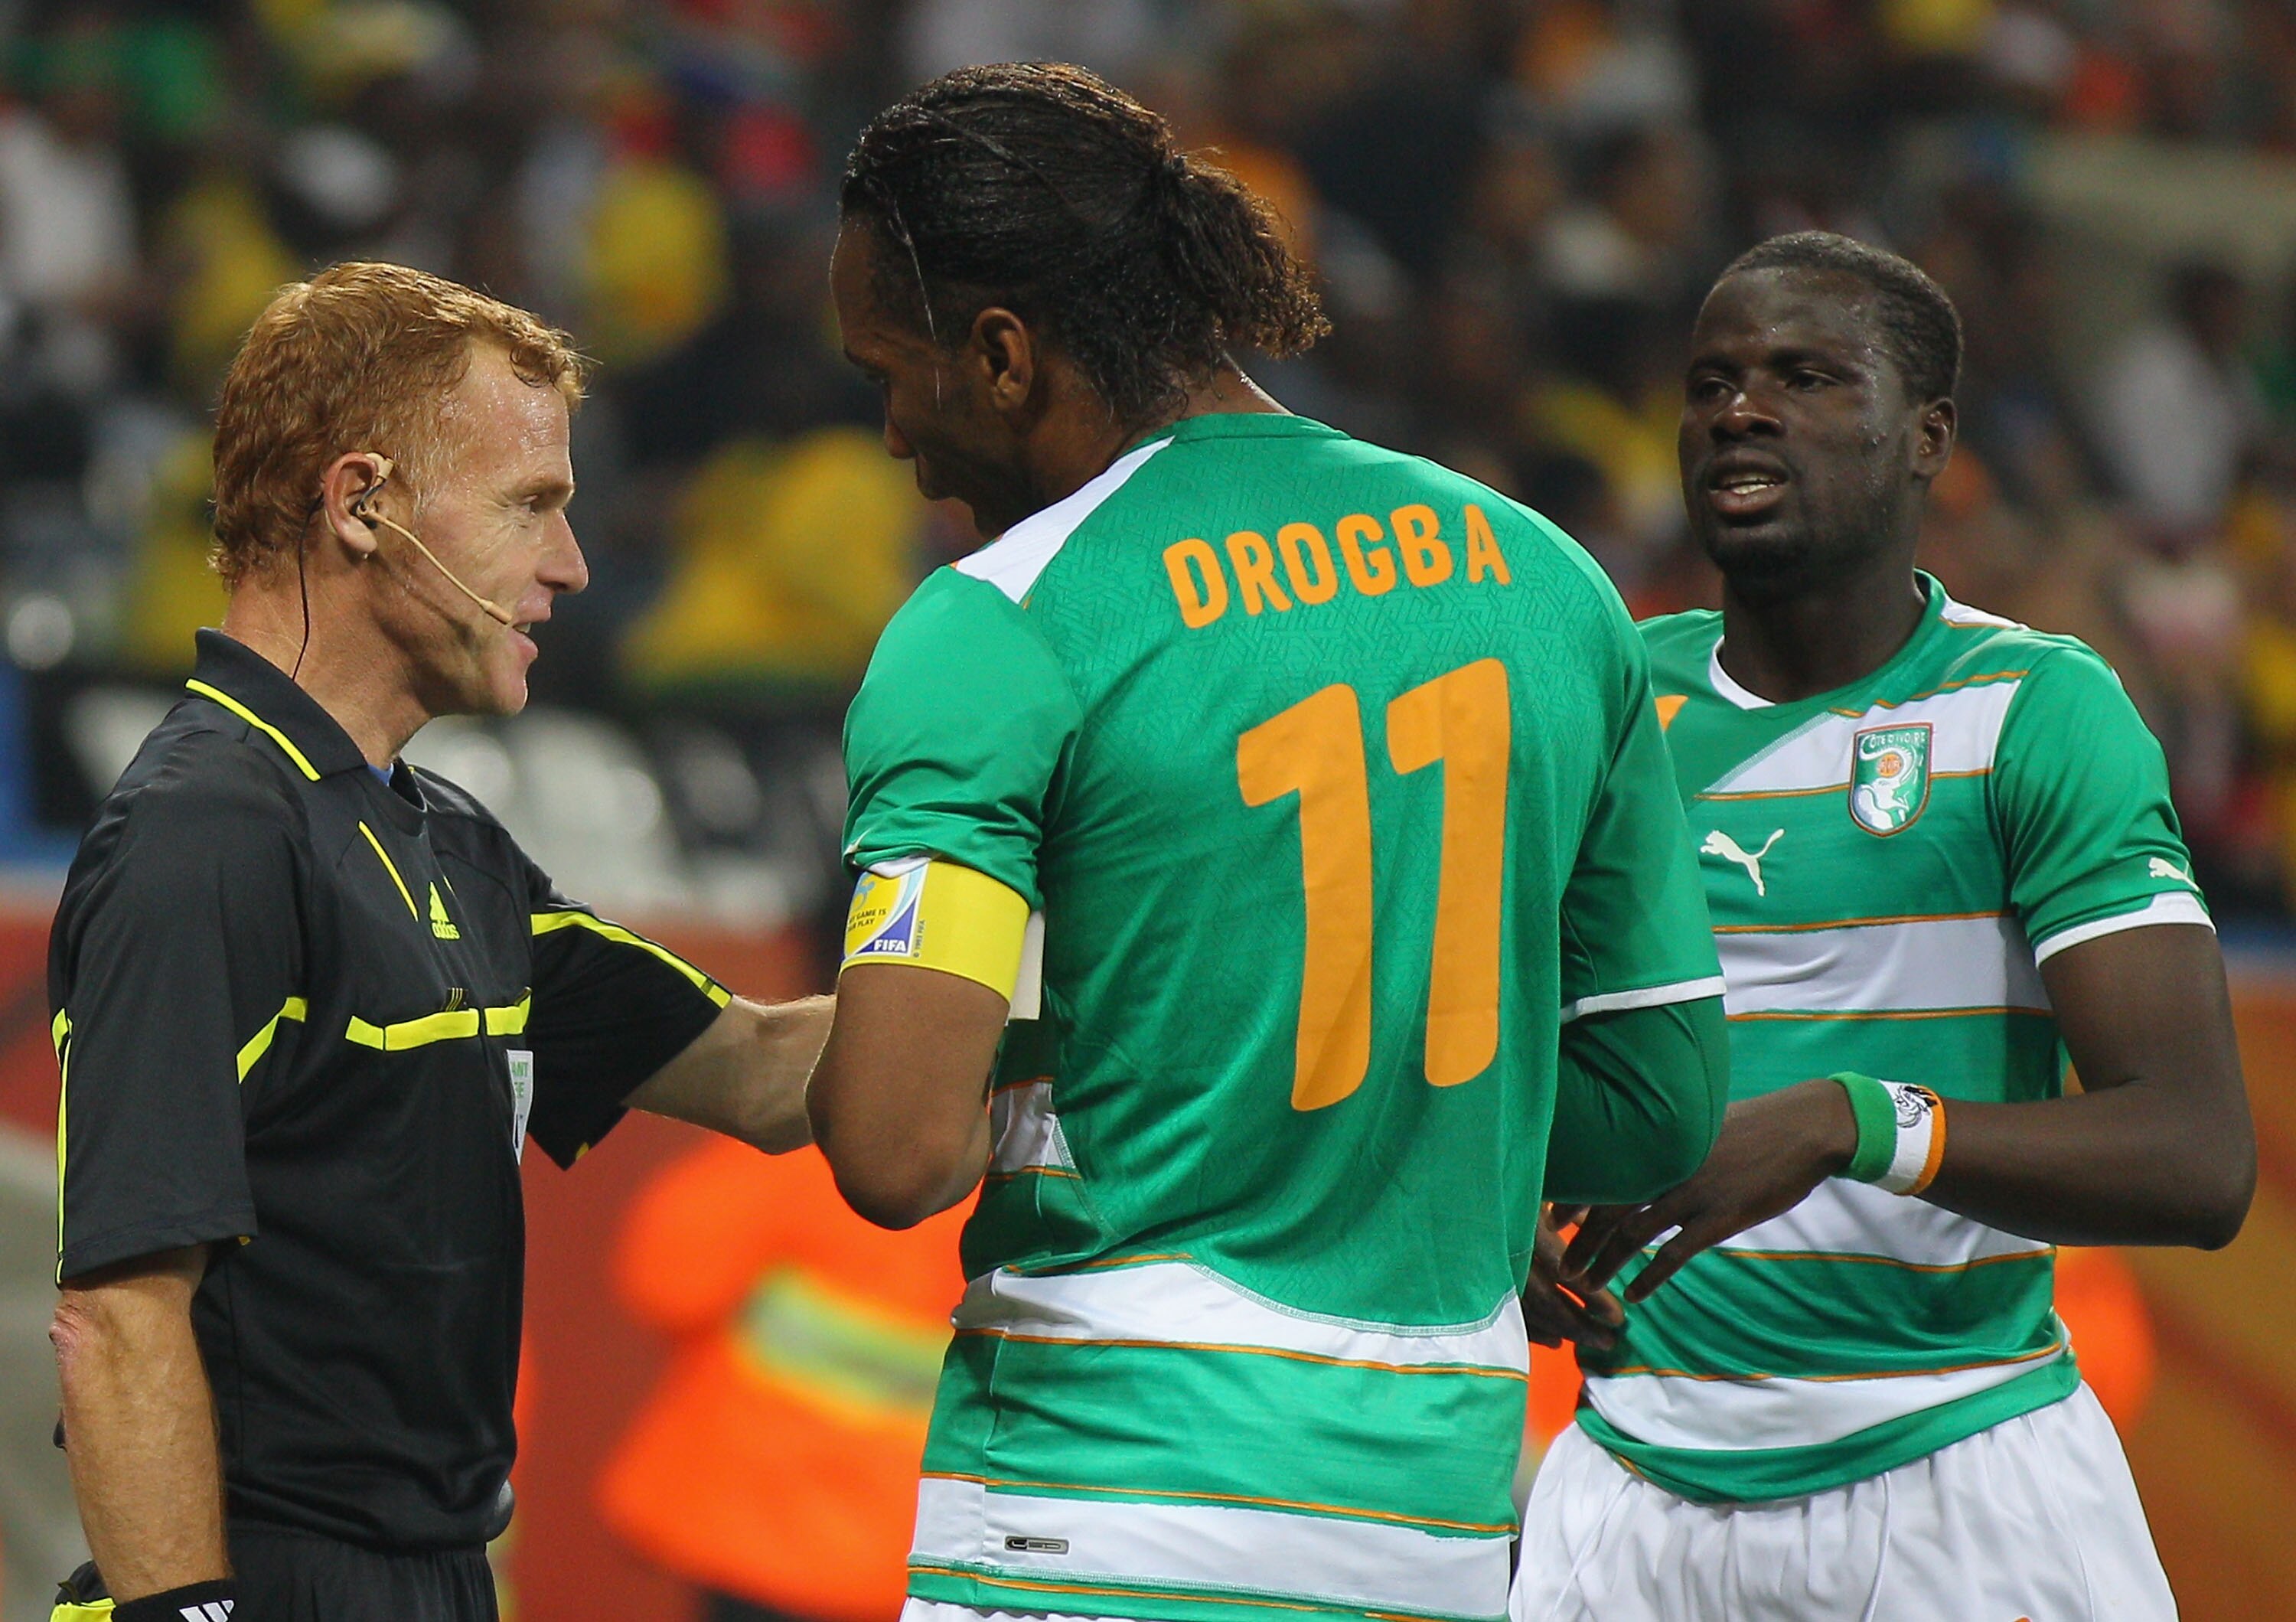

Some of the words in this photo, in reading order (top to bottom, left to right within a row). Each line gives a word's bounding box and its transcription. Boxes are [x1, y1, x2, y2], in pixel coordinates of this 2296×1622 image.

[1163, 504, 1512, 628] DROGBA
[1236, 658, 1511, 1111] 11
[857, 918, 876, 927] PLAY
[873, 939, 907, 952] FIFA
